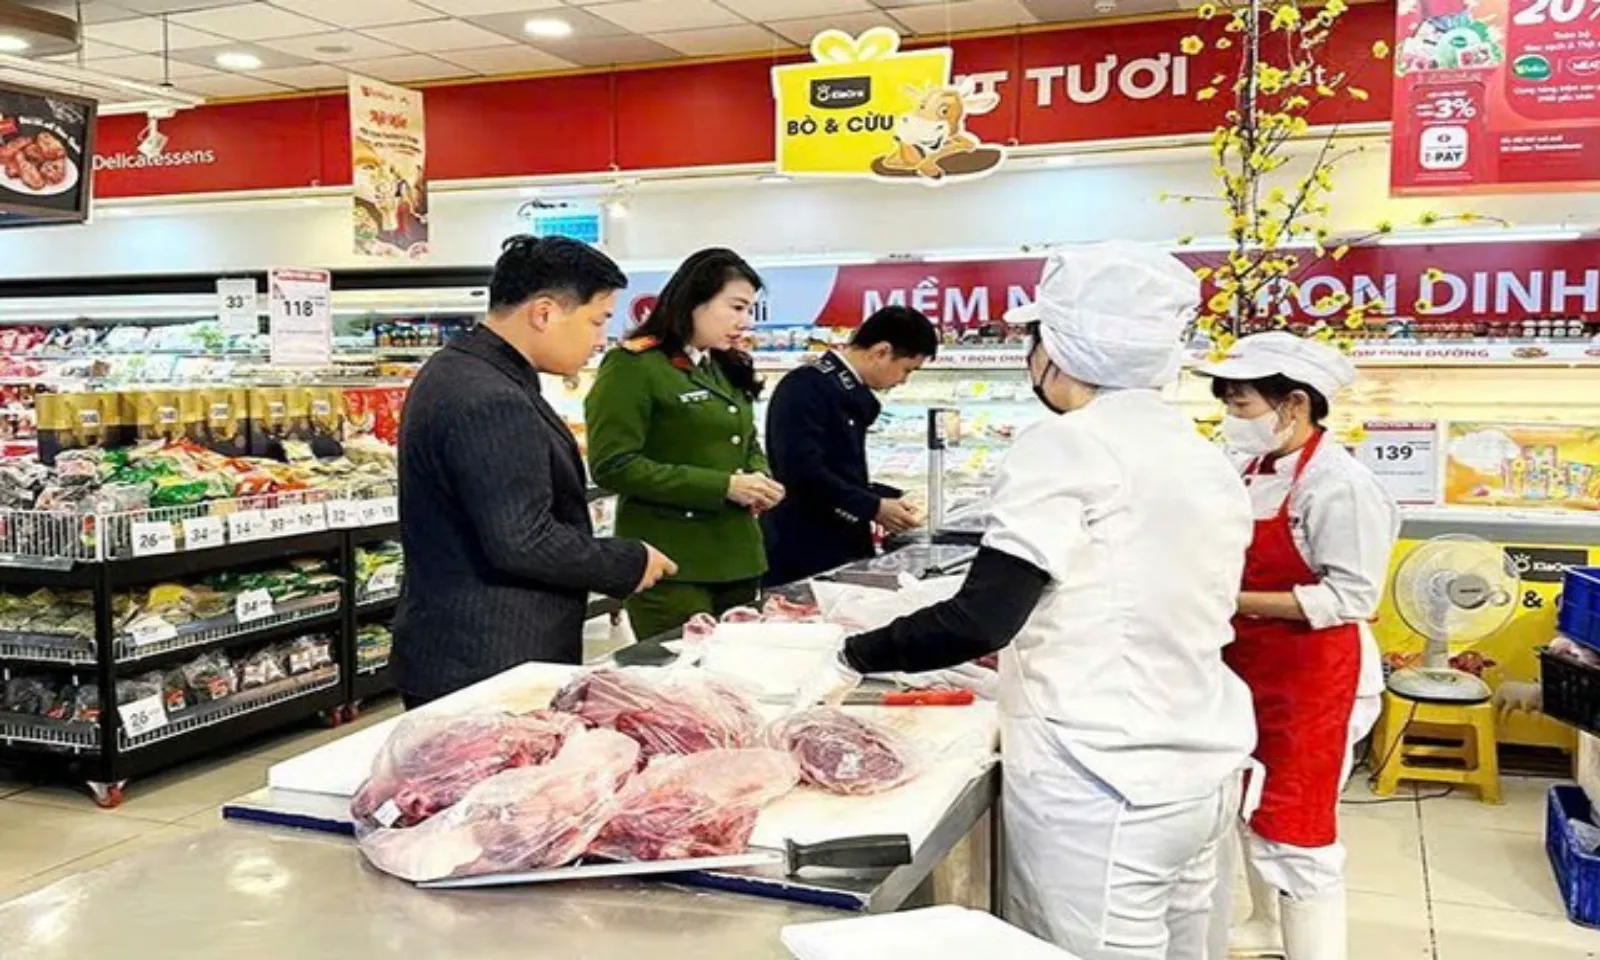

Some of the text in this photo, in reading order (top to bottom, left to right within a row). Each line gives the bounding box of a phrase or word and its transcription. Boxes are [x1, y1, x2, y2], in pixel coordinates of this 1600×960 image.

[1025, 52, 1188, 107] TƯƠI
[787, 110, 894, 136] BÒ & CỪU
[92, 149, 216, 171] Delicatessens
[225, 295, 244, 309] 33
[863, 276, 989, 324] MỀM
[1419, 269, 1600, 314] DINH
[284, 300, 313, 317] 118
[1373, 444, 1414, 461] 139
[139, 532, 159, 549] 26
[1523, 590, 1543, 609] &
[130, 711, 149, 728] 26
